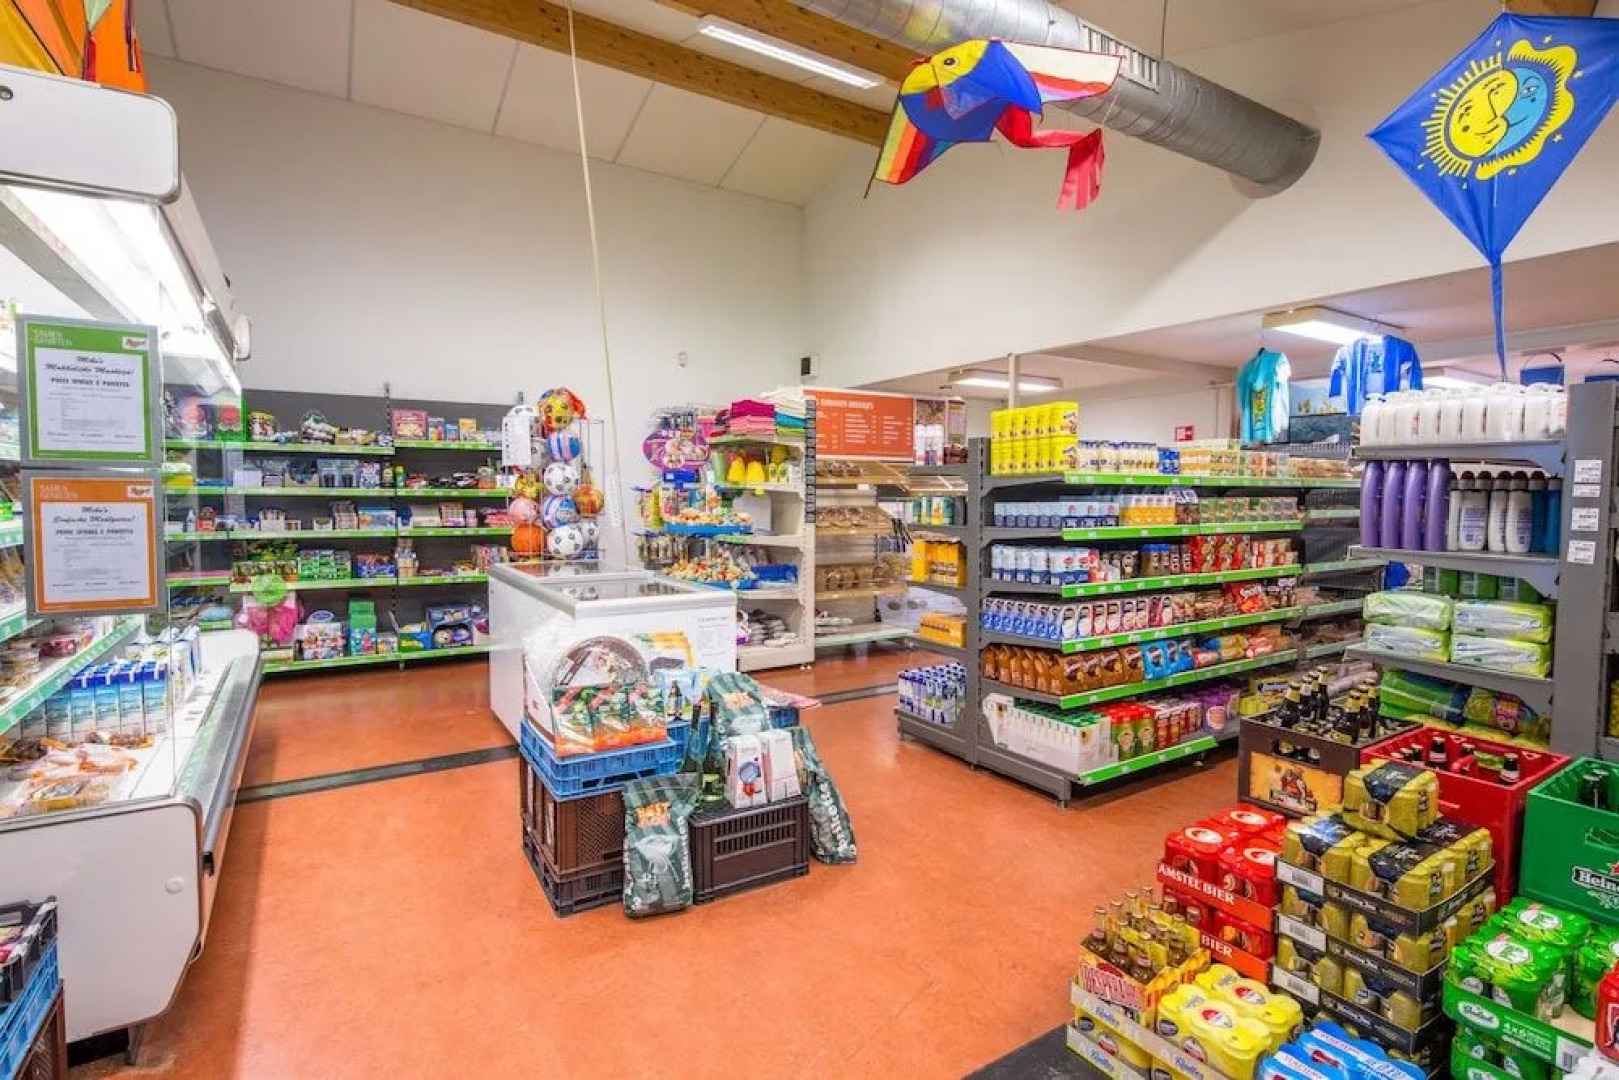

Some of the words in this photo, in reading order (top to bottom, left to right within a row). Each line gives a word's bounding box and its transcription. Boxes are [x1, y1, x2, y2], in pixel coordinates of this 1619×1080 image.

[1158, 863, 1201, 891] AMSTEL
[1202, 882, 1235, 906] BIER
[1201, 934, 1233, 958] BIER
